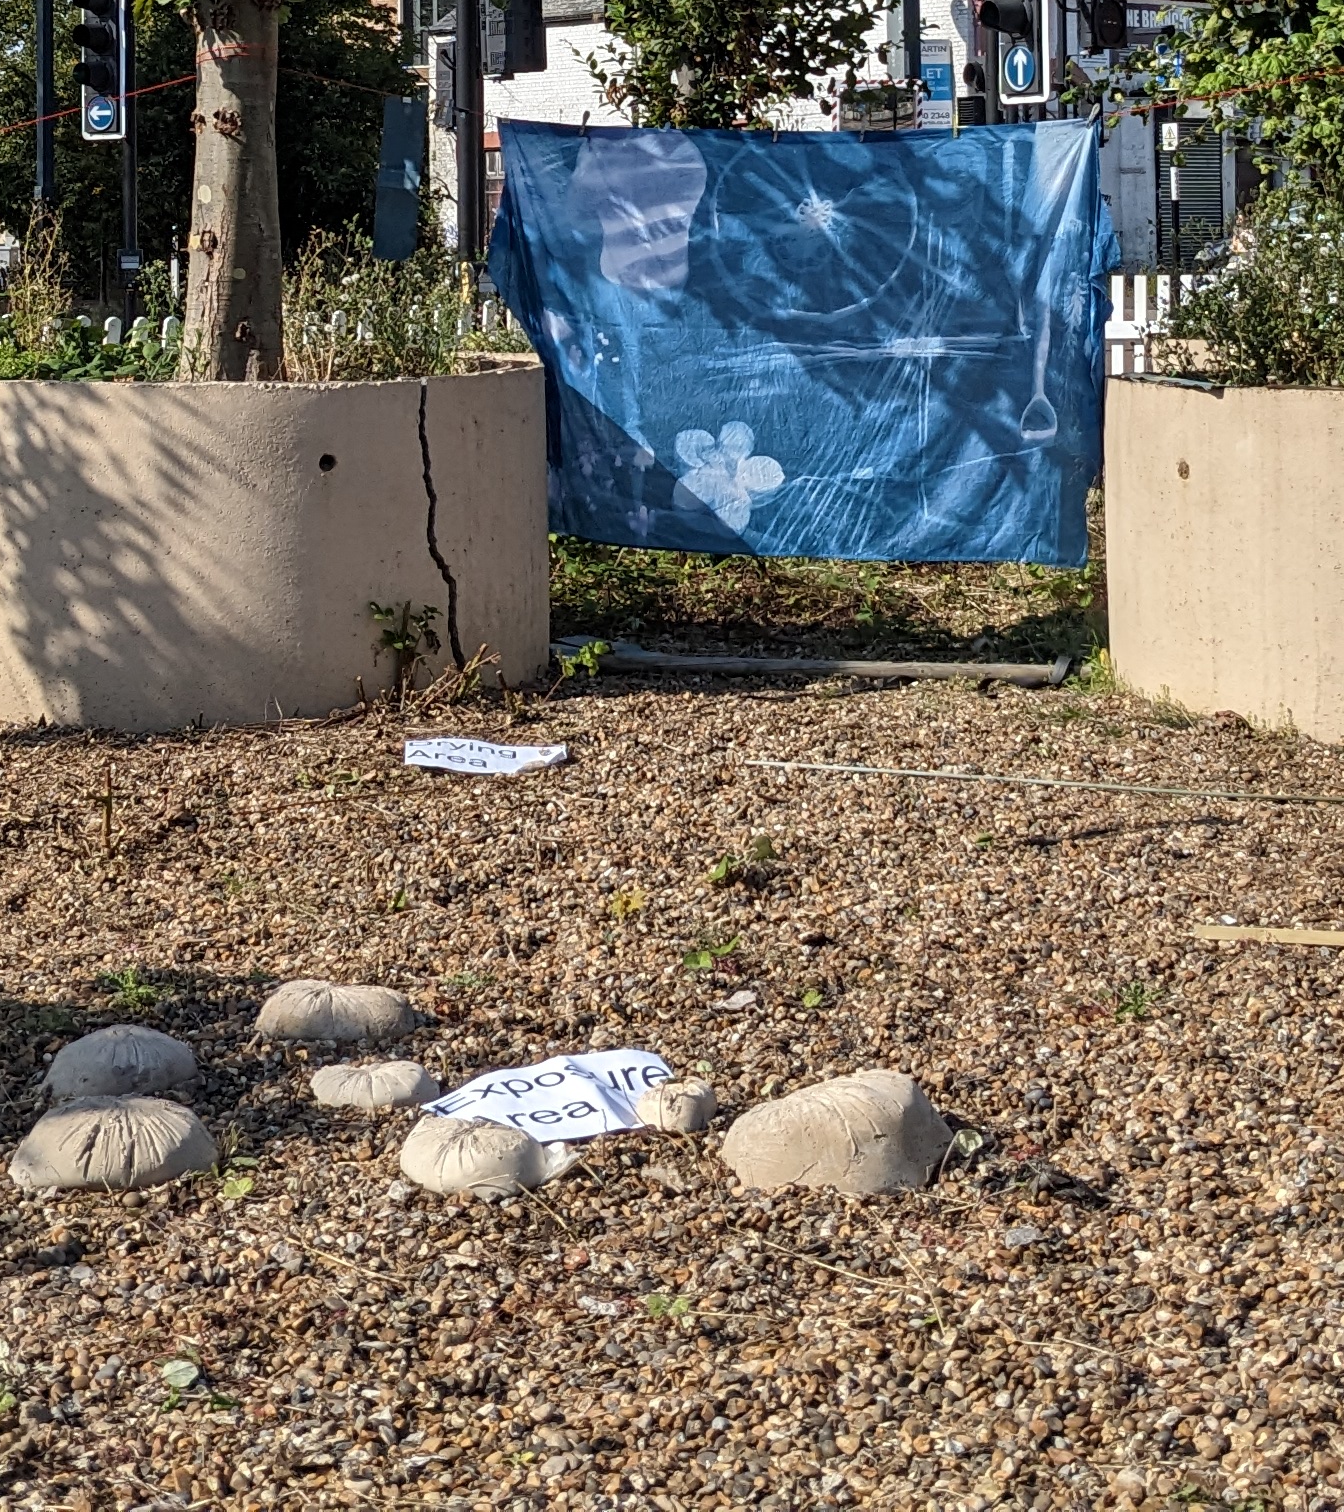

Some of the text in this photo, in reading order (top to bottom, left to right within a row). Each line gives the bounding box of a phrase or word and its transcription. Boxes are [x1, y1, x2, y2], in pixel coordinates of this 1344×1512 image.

[921, 45, 947, 53] ARTIN
[921, 68, 943, 79] ET
[407, 749, 488, 769] Area
[408, 741, 517, 759] Drying
[432, 1063, 670, 1116] Exposure
[472, 1099, 600, 1128] rea
